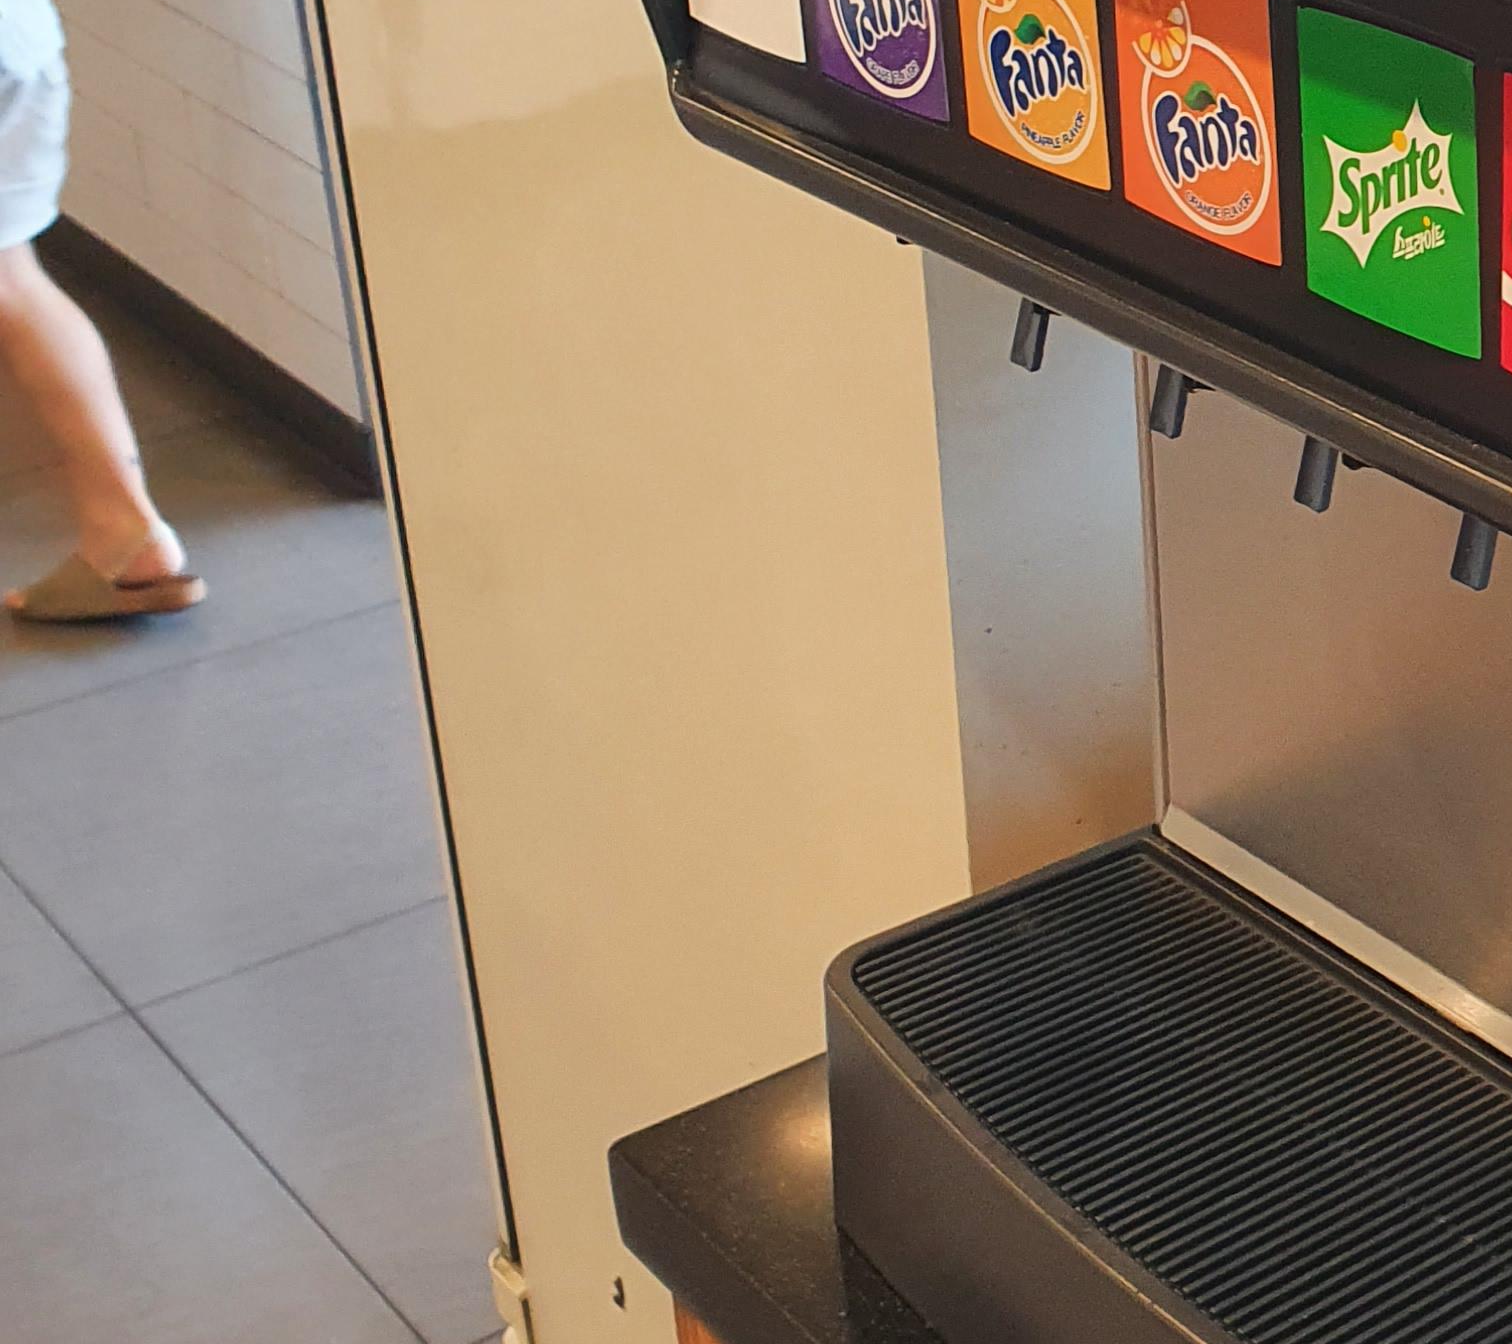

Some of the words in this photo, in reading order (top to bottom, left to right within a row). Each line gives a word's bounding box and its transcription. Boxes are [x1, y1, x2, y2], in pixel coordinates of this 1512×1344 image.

[988, 27, 1088, 120] Fanta
[1152, 91, 1260, 188] Fanta
[1337, 129, 1443, 236] Sprite
[1392, 215, 1446, 260] 스프라이트
